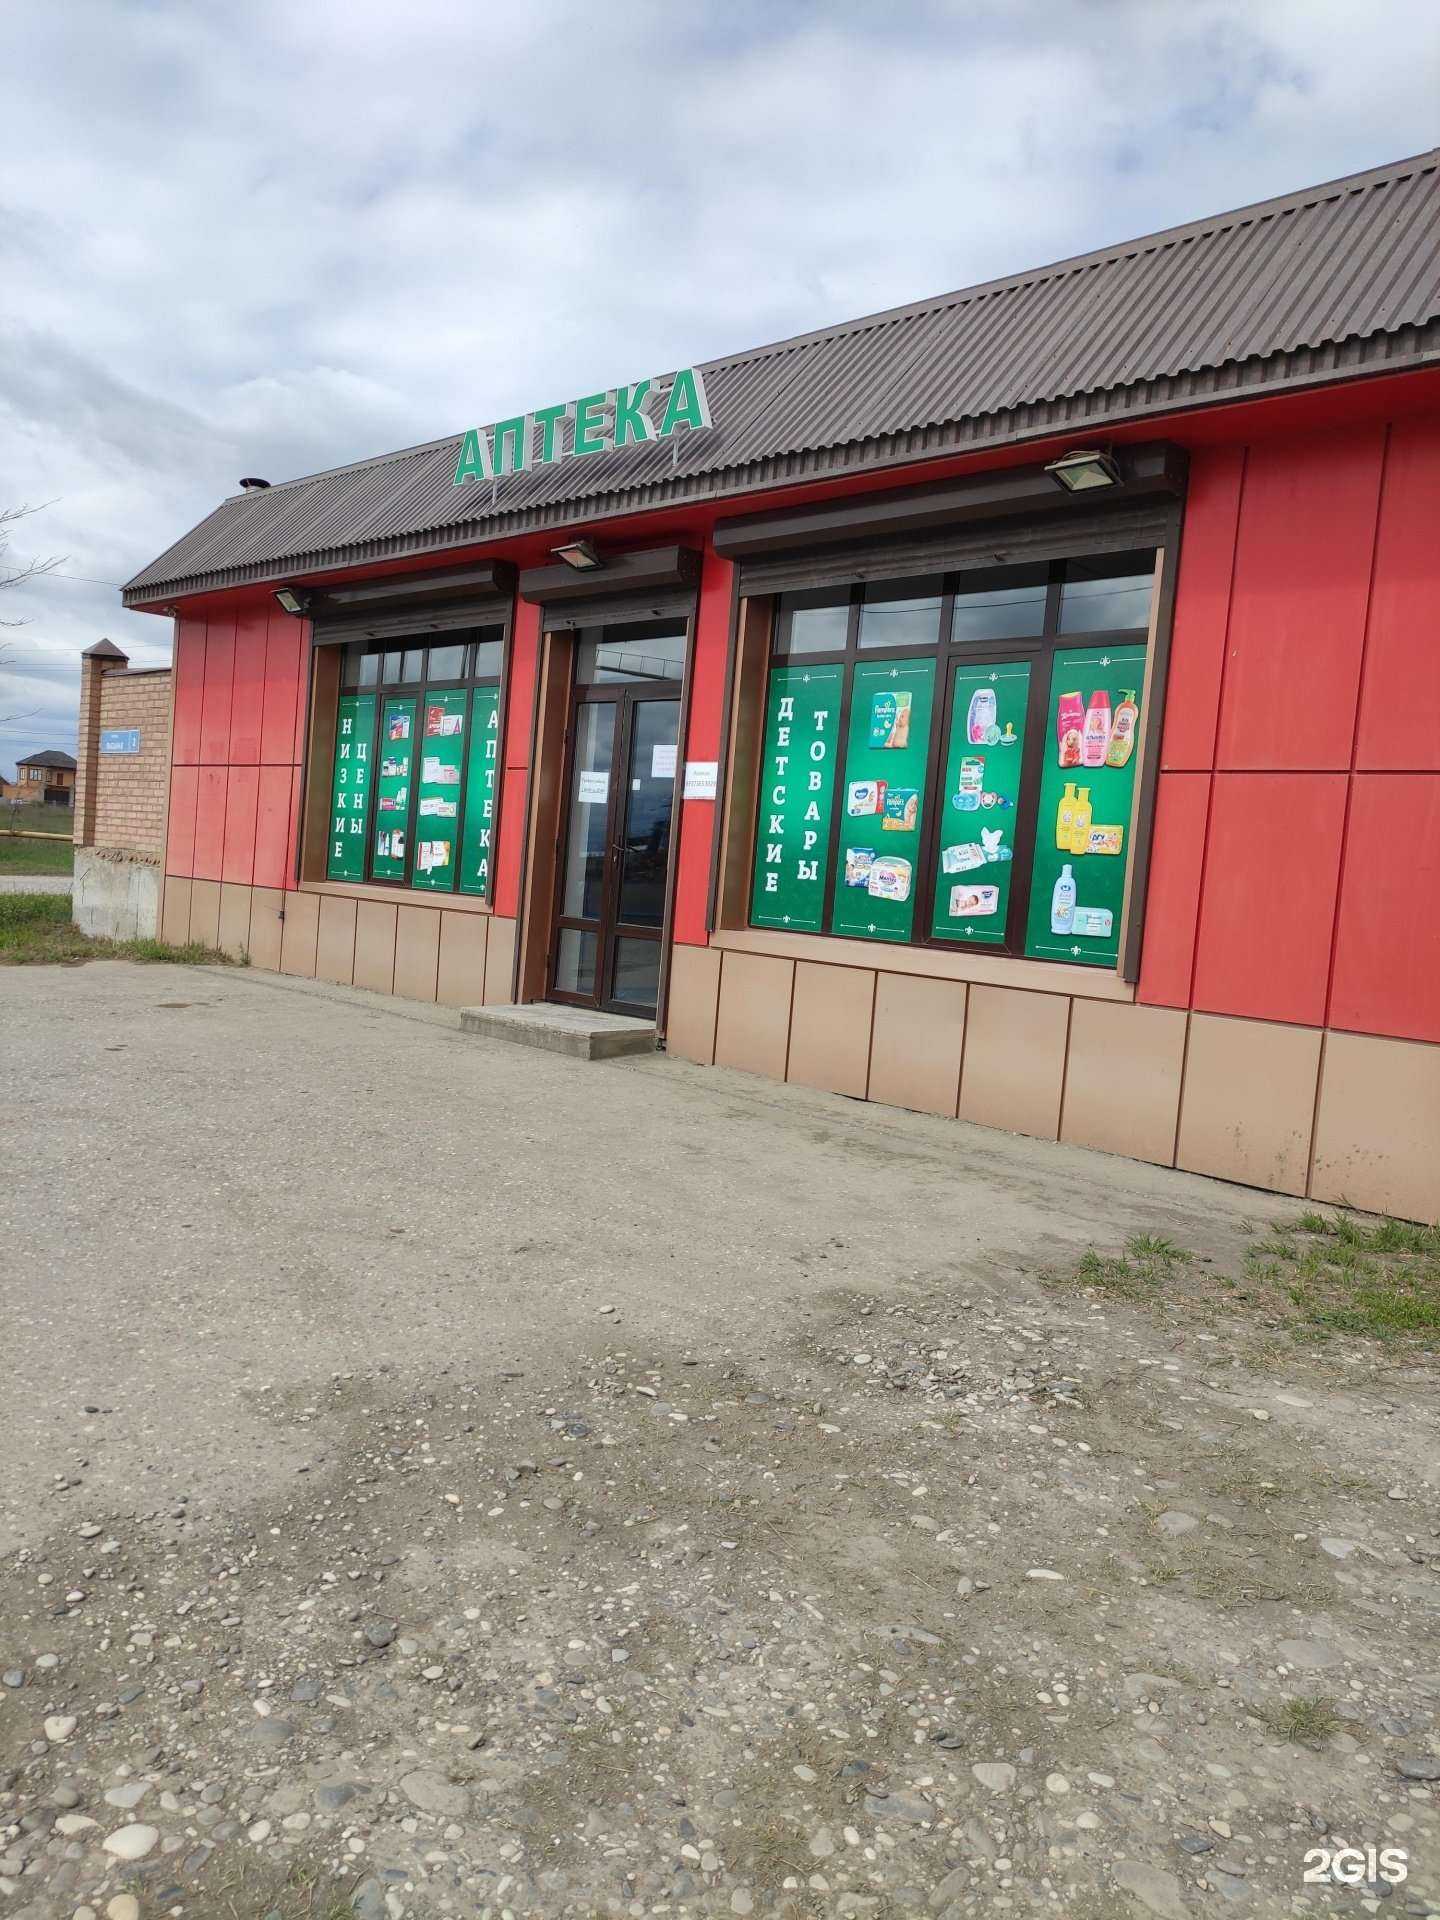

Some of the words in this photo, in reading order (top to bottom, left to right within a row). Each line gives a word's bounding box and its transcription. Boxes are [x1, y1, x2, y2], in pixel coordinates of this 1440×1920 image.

[452, 366, 709, 486] АПТЕКА
[334, 719, 352, 858] НИЗКИЕ
[350, 743, 367, 834] ЦЕНЫ
[477, 710, 499, 877] АПТЕКА
[765, 697, 794, 892] ДЕТСКИЕ
[797, 711, 828, 881] ТОВАРЫ
